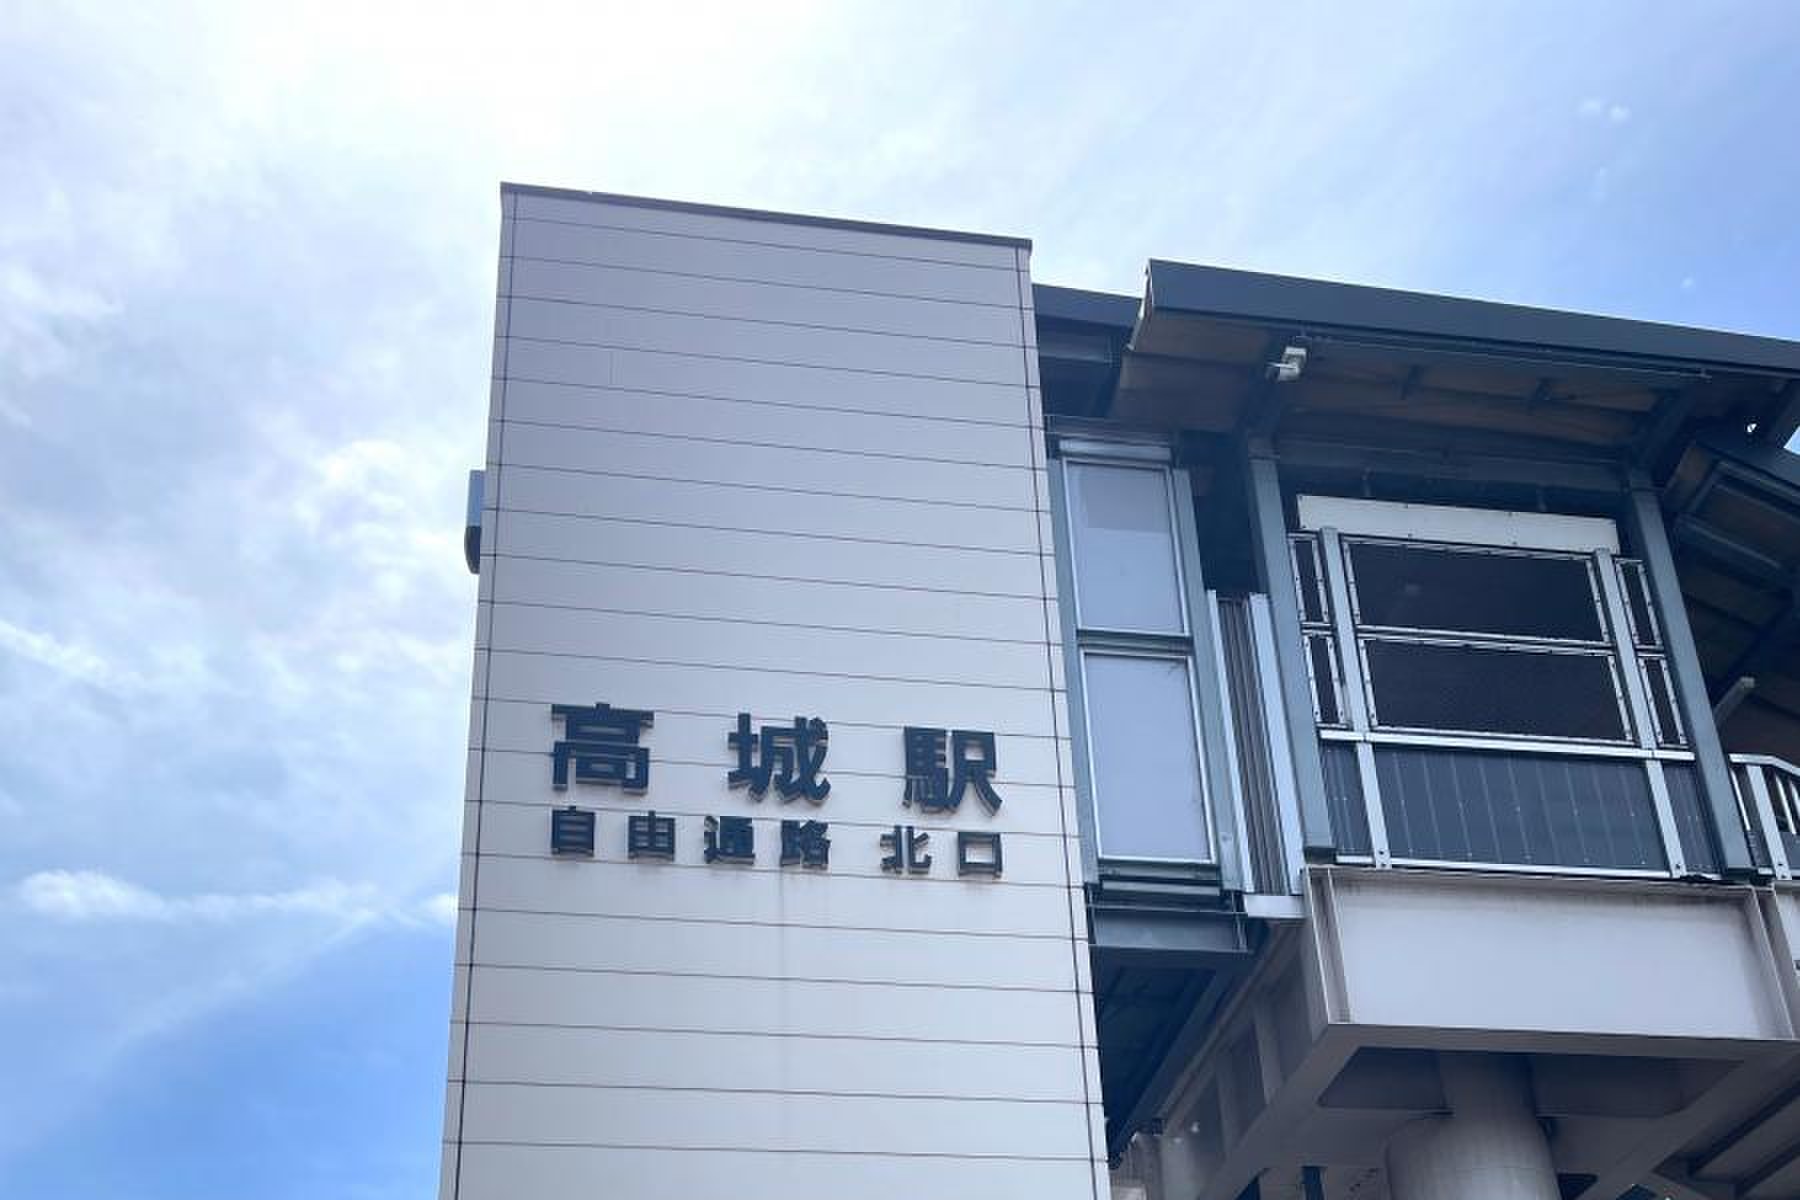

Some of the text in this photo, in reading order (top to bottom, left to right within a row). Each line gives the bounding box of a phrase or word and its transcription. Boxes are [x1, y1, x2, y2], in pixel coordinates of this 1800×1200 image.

[551, 702, 1003, 816] 高城駅
[551, 805, 1003, 879] 自由通路 北口
